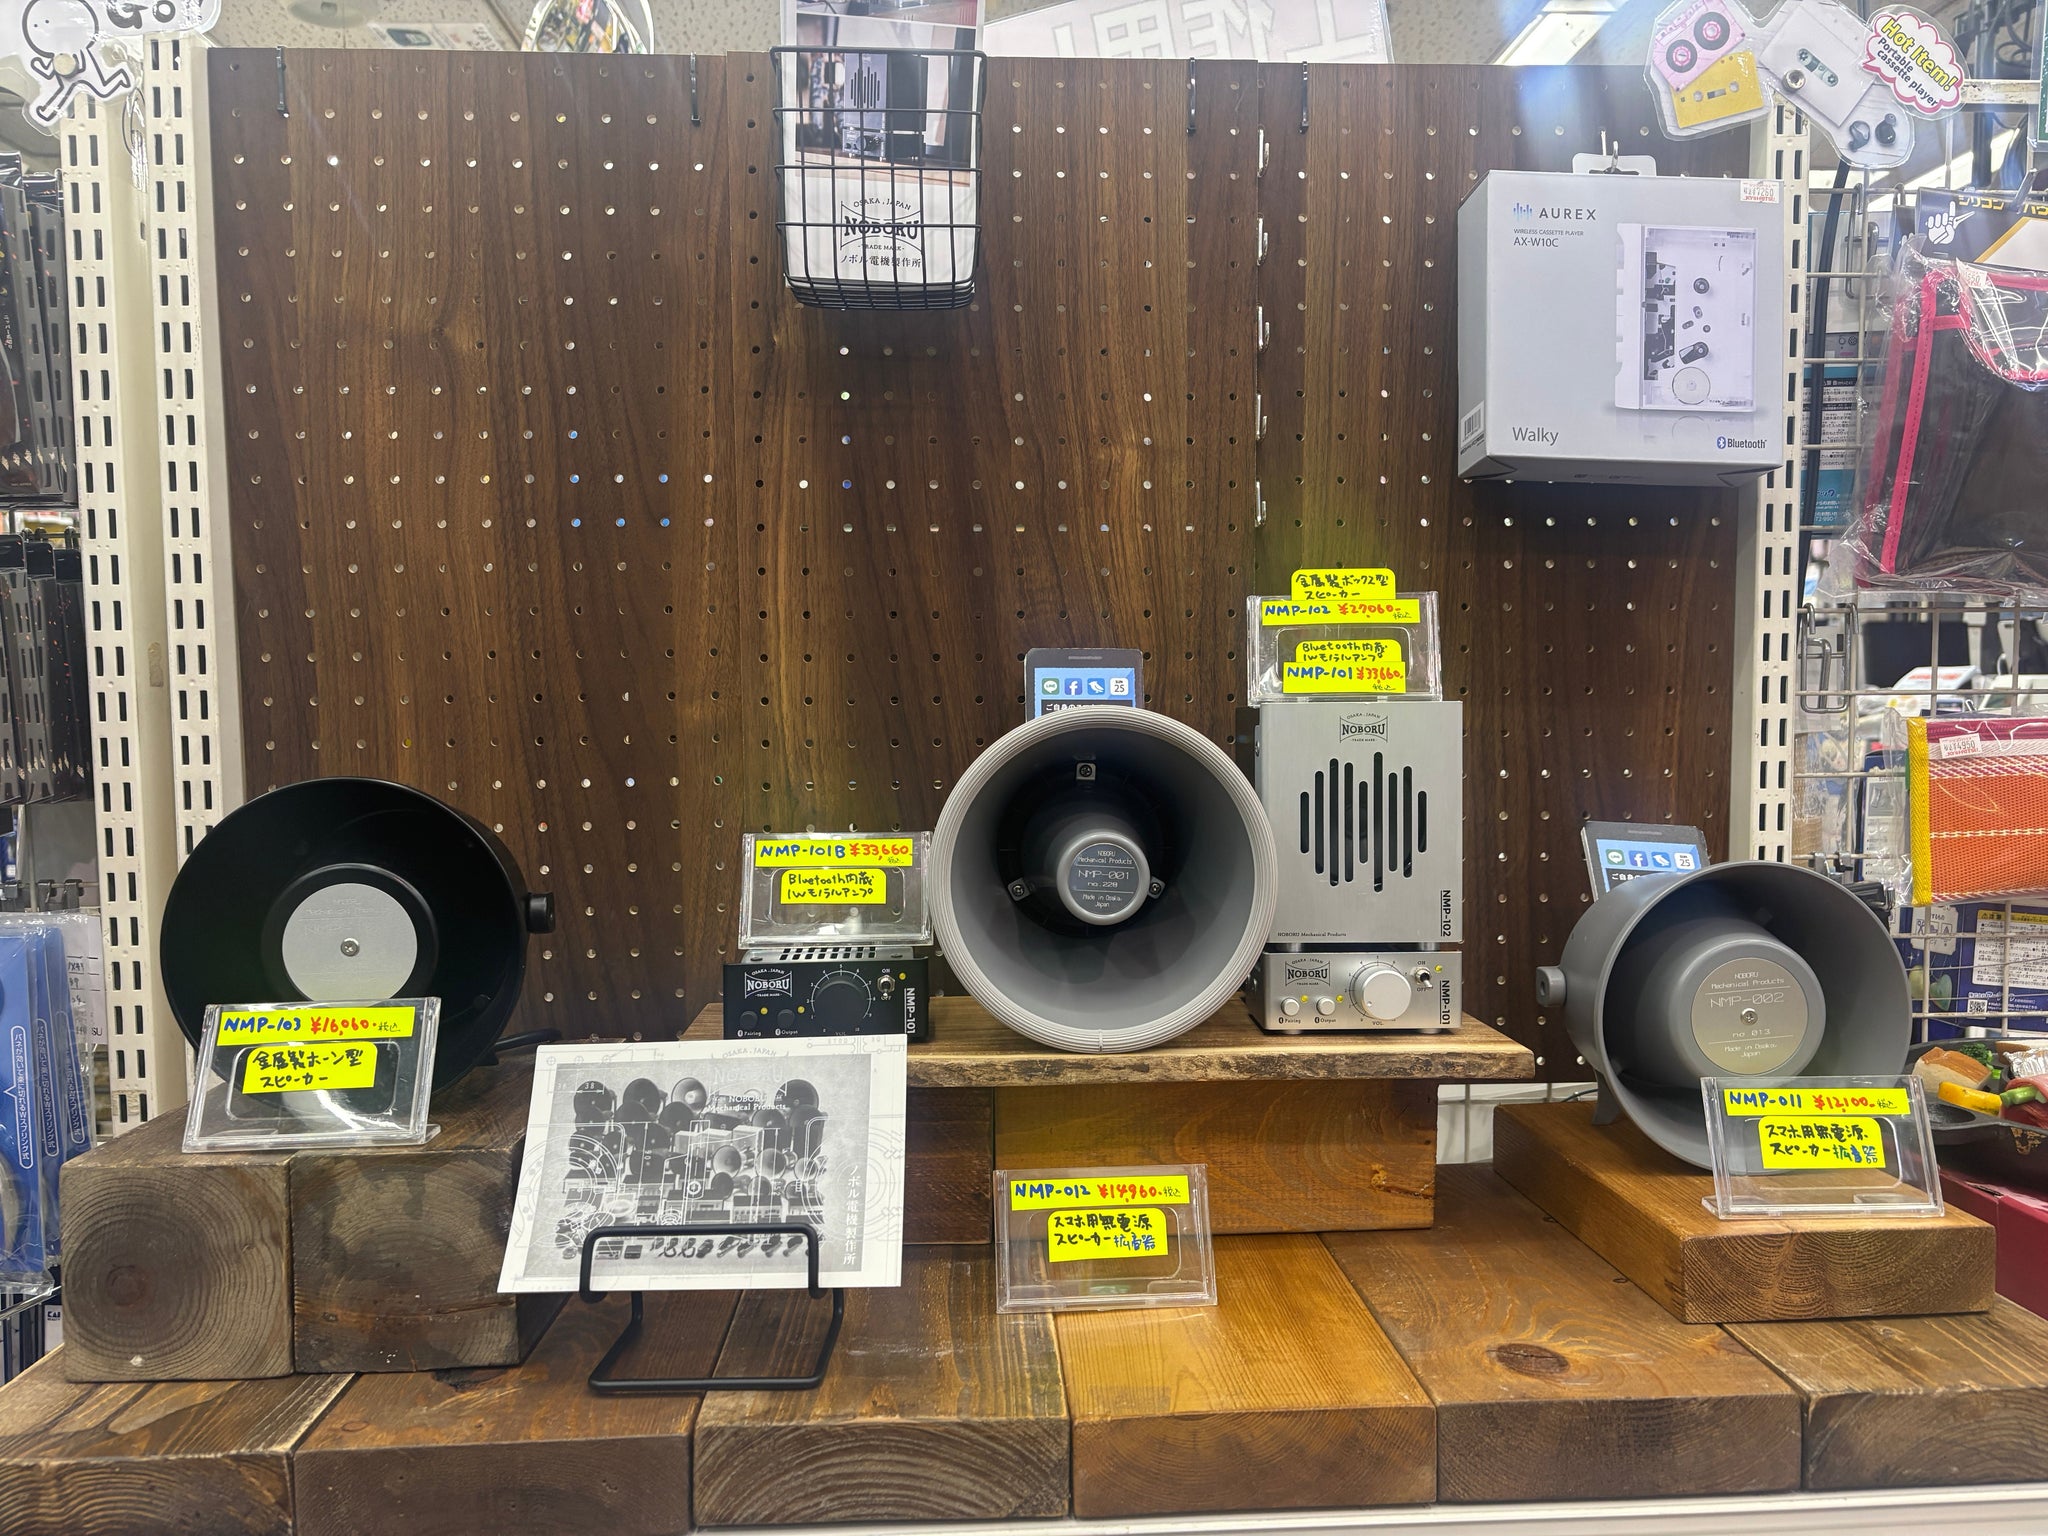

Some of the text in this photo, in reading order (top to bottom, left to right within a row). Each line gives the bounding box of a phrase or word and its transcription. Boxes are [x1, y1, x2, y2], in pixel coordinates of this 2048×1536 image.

[1878, 37, 1913, 73] Portable
[1881, 18, 1958, 91] Hot Item!
[1877, 50, 1938, 106] cassette player
[1539, 208, 1596, 221] AUREX
[1513, 228, 1538, 236] WIRELESS
[1513, 237, 1559, 248] AX-W10C
[1512, 427, 1559, 446] Walky
[1305, 589, 1360, 600] スピーカー
[1264, 605, 1331, 616] NMP-102
[1287, 666, 1353, 680] NMP-101
[1114, 684, 1125, 693] 25
[1342, 723, 1386, 736] NOBORU
[760, 844, 845, 858] NMP-101B
[1680, 859, 1691, 867] 25
[1078, 869, 1129, 880] NMP-001
[1094, 901, 1110, 909] Japan
[1442, 889, 1451, 937] NMP-102
[1287, 968, 1328, 980] NOBORU
[746, 978, 790, 992] NOBORU
[1711, 977, 1785, 990] Mechanical Products
[1441, 980, 1450, 1025] NMP-101
[1710, 992, 1785, 1008] NMP-002
[906, 987, 916, 1034] NMP-101
[224, 1016, 301, 1033] NMP-103
[252, 1048, 363, 1069] 金属製ホーン型
[260, 1074, 329, 1088] スピーカー
[1729, 1091, 1802, 1109] NMP-011
[1015, 1183, 1091, 1199] NMP-012
[843, 1164, 860, 1265] ノボル電機製作所
